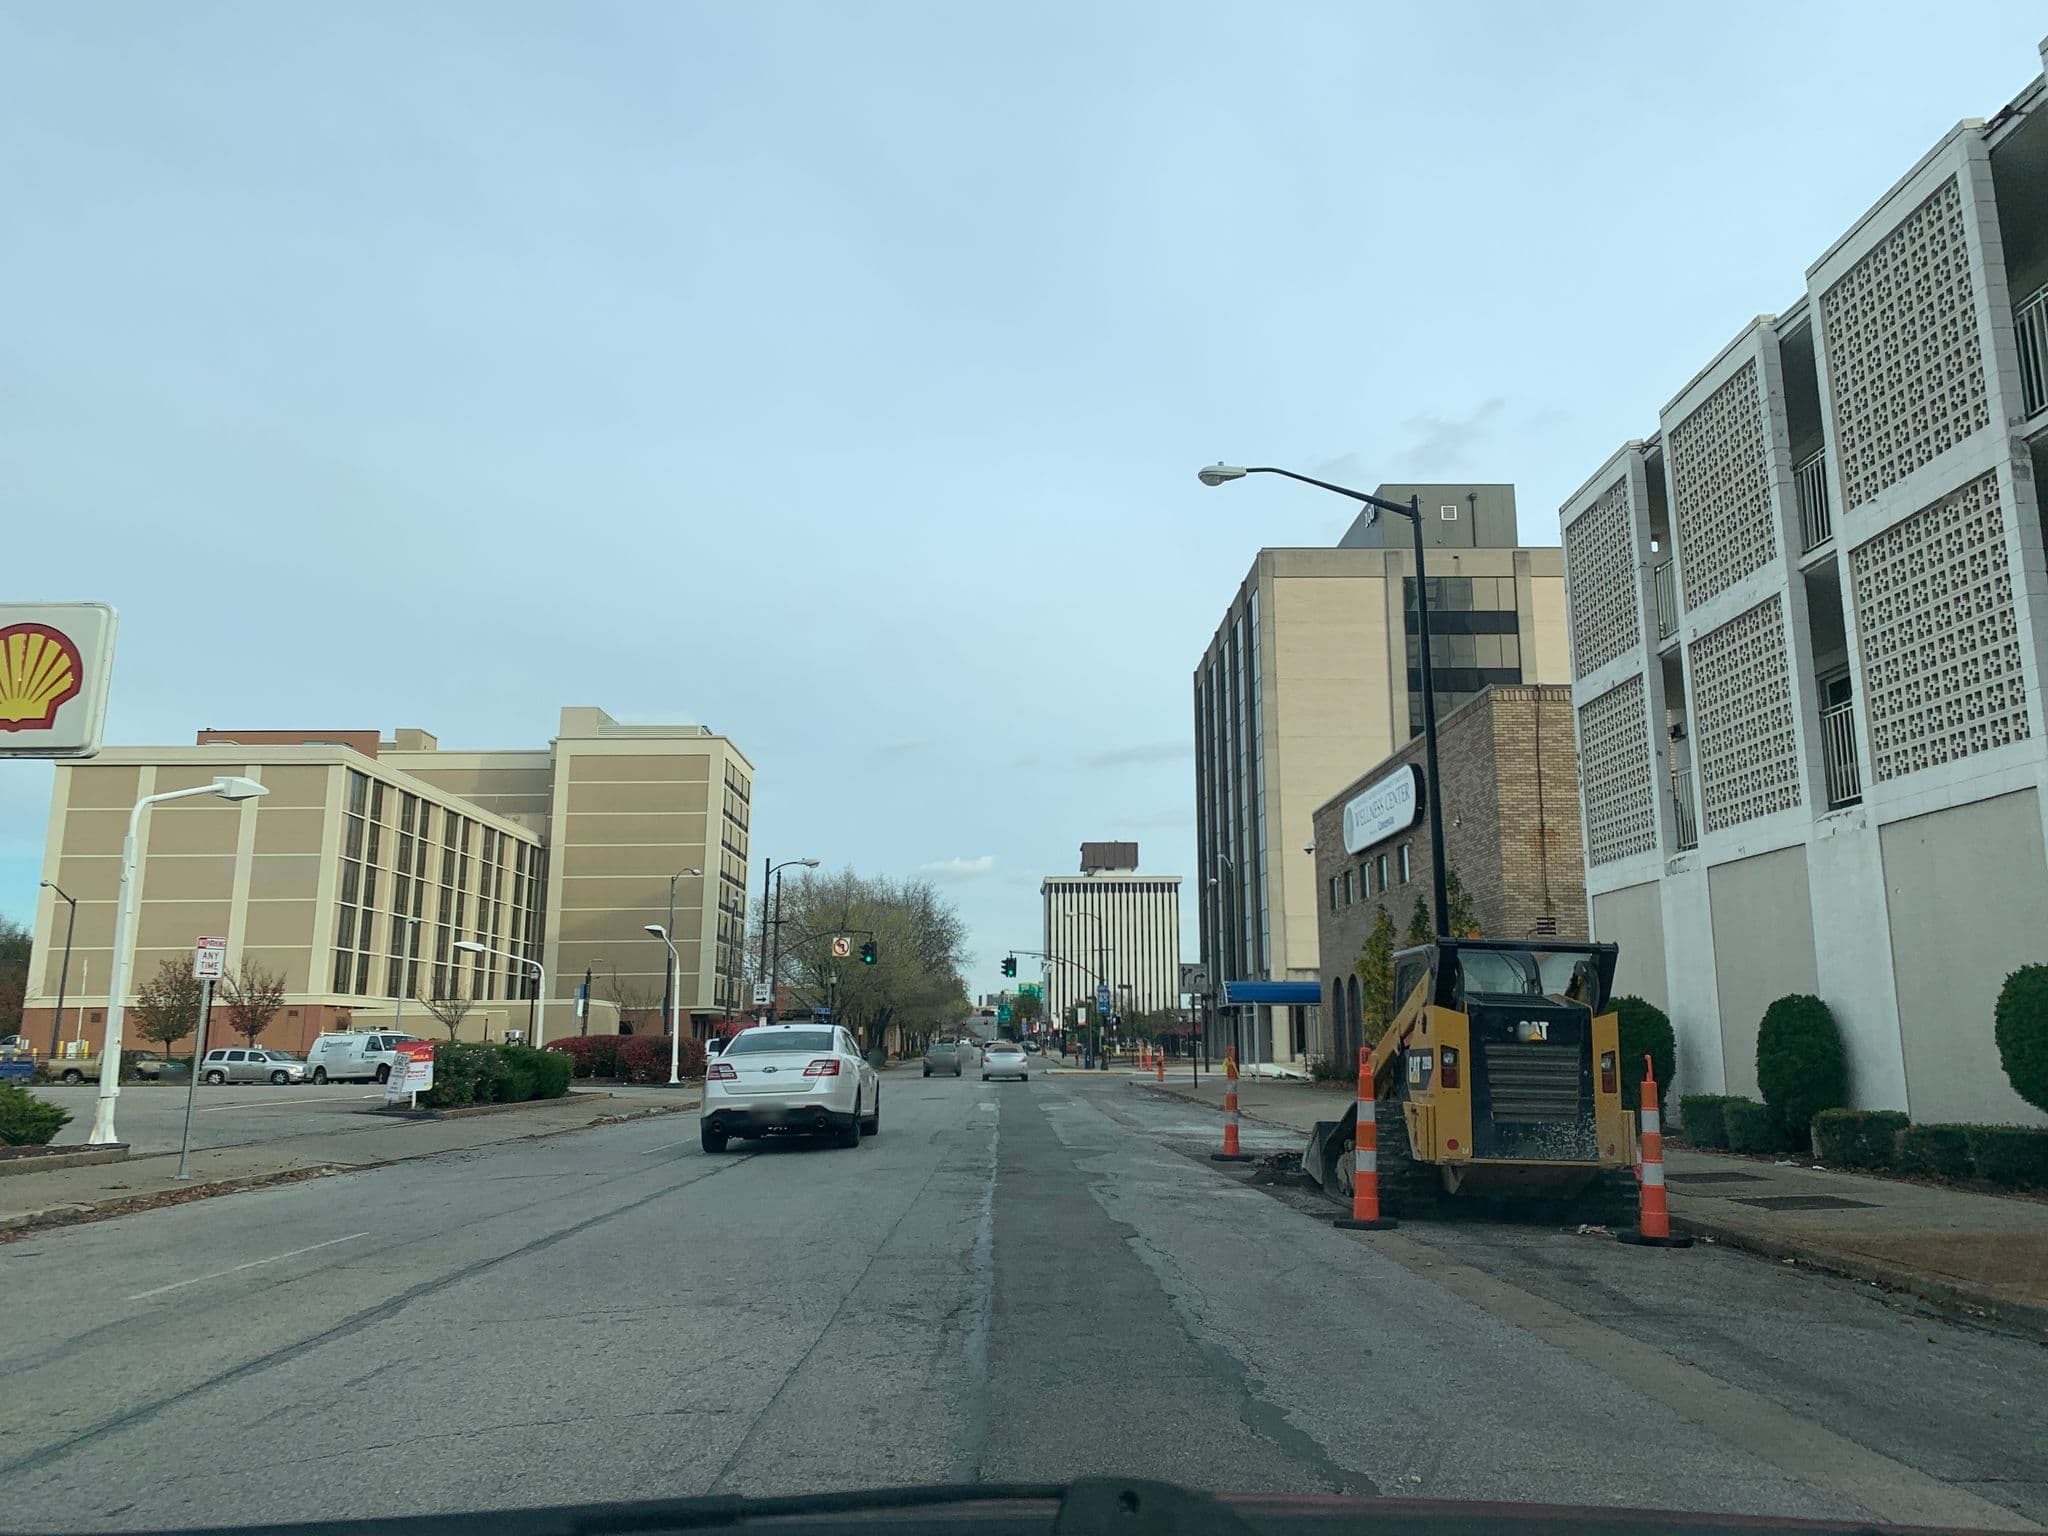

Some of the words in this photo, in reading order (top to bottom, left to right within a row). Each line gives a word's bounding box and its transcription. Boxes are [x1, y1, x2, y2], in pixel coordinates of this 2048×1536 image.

[1354, 797, 1385, 828] WELLNESS
[1384, 782, 1411, 812] CENTER
[202, 951, 220, 960] ANY
[200, 961, 220, 971] TIME
[1409, 1055, 1421, 1084] CAT
